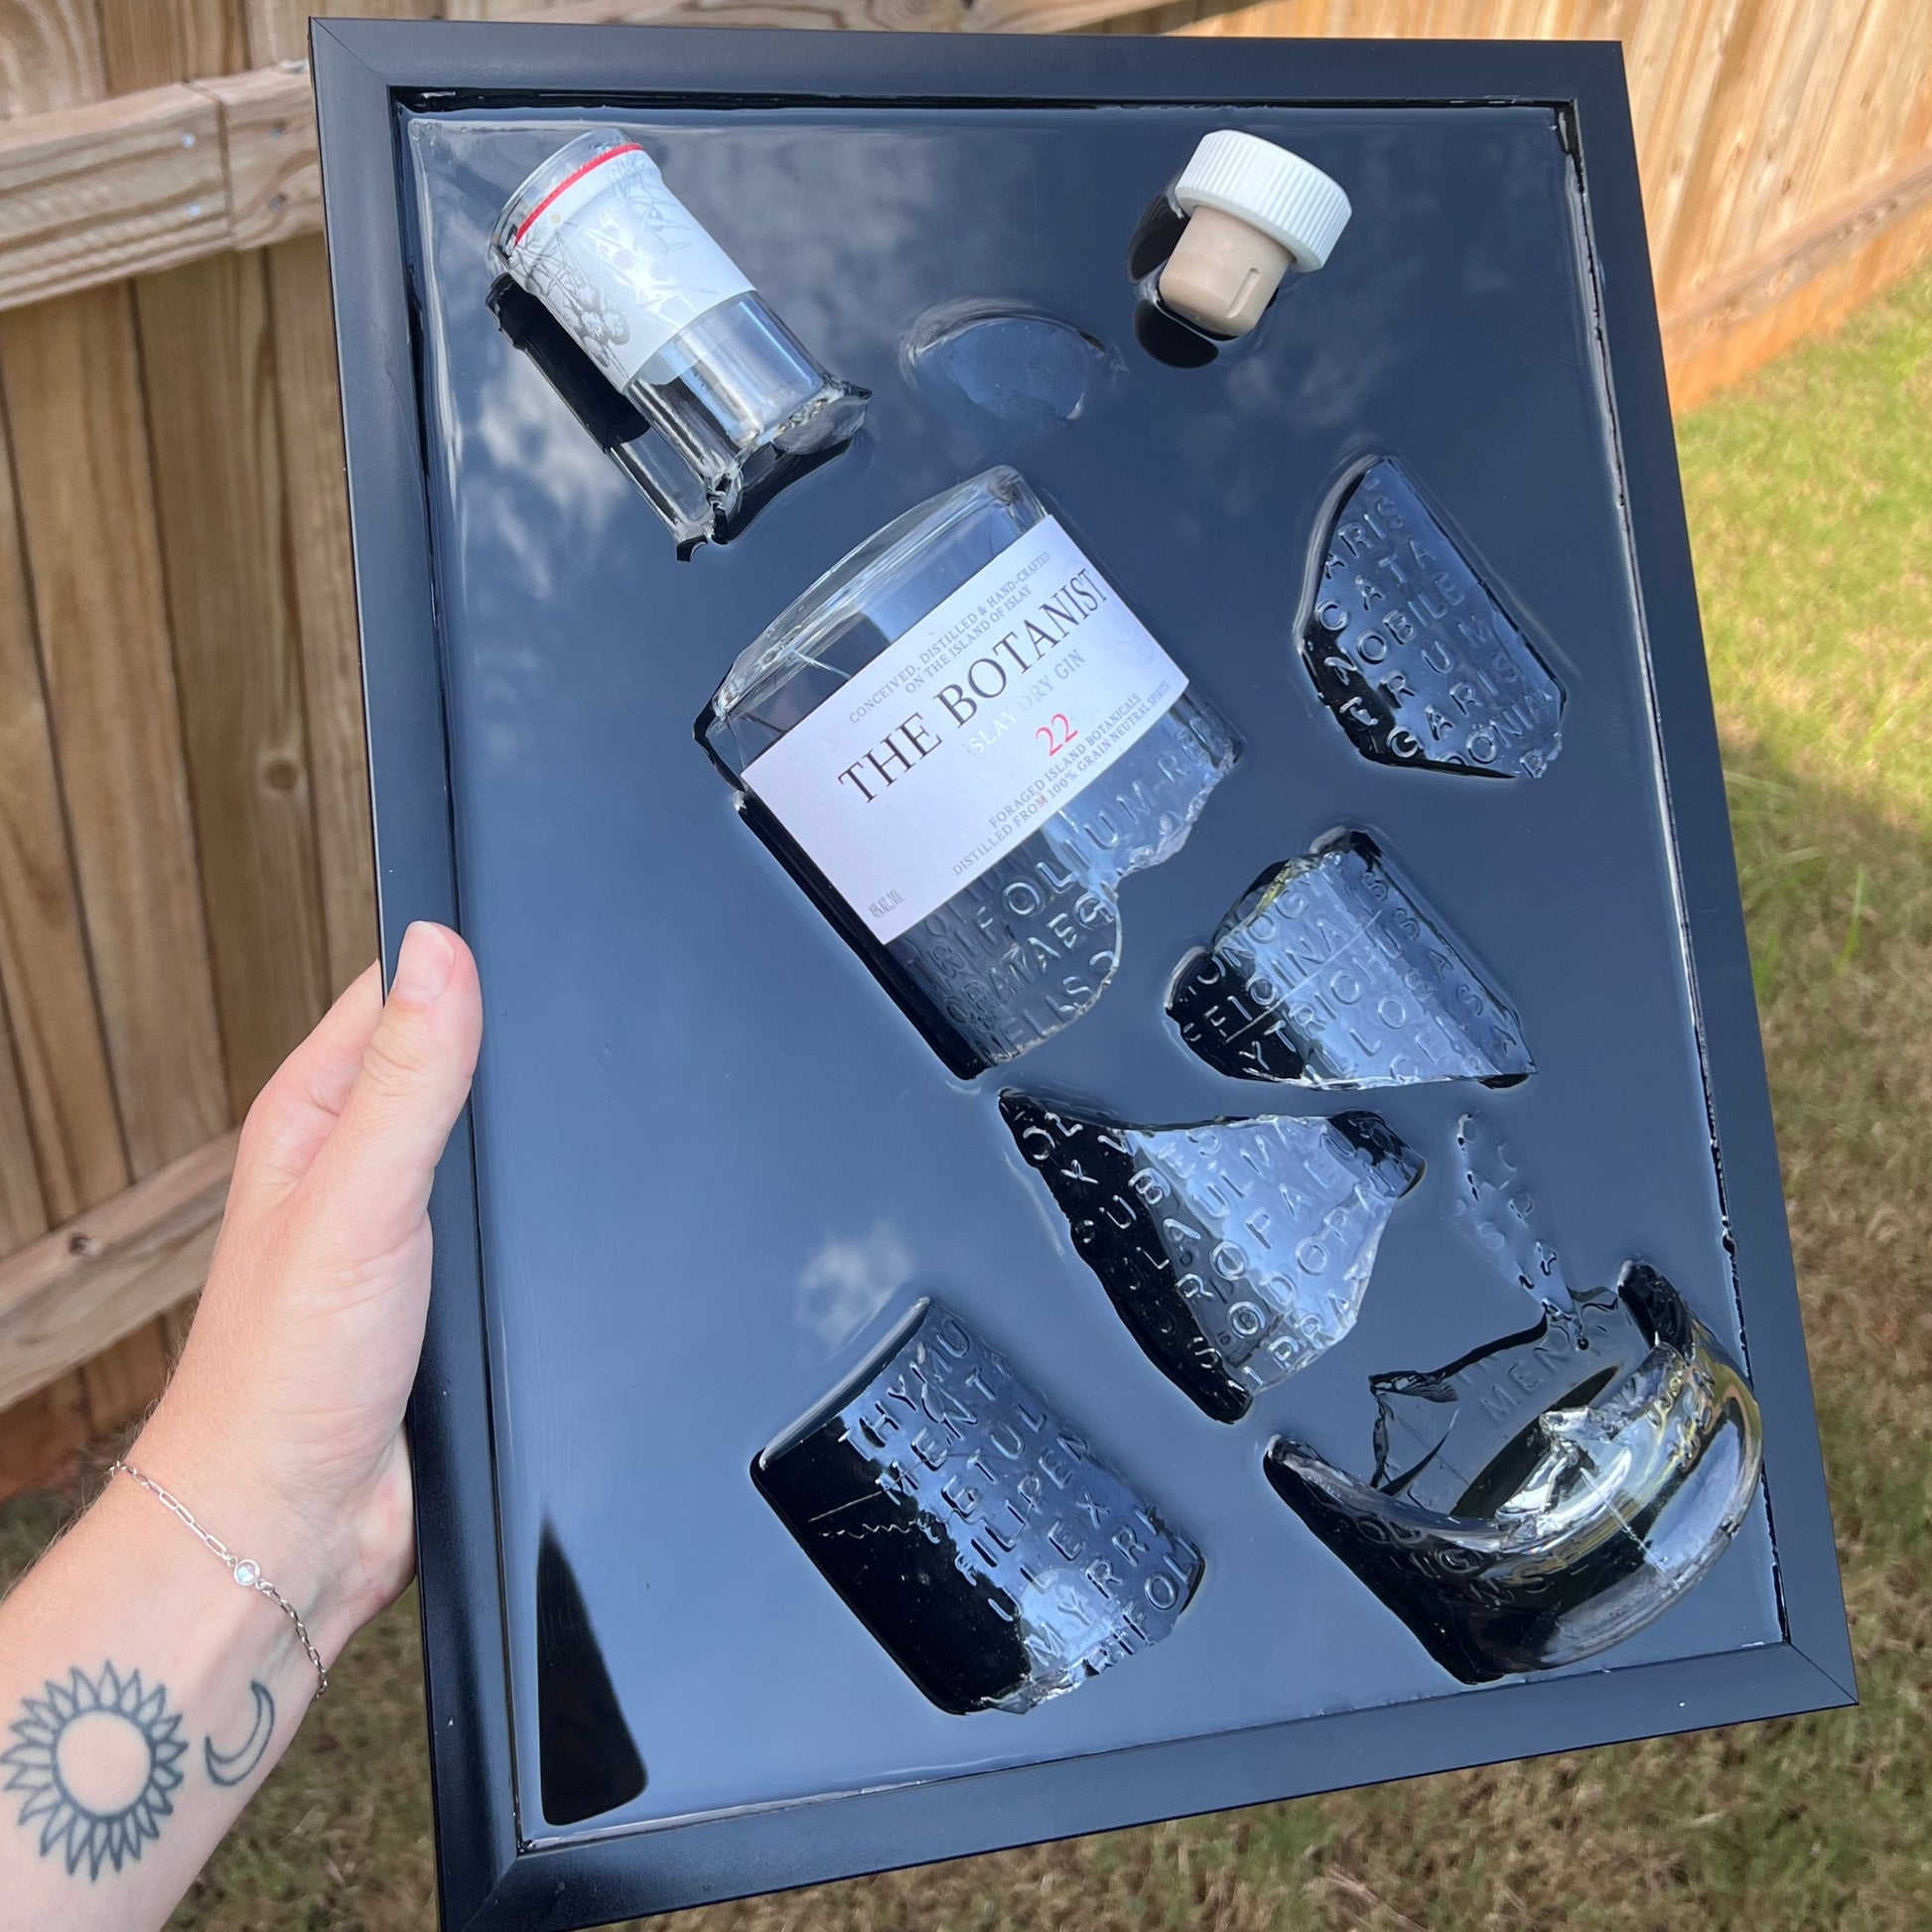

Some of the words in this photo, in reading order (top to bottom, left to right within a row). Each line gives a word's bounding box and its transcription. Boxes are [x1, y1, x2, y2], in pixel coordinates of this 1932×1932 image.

[904, 673, 927, 694] ON
[923, 653, 951, 678] THE
[948, 619, 992, 658] ISLAND
[988, 605, 1006, 622] OF
[1003, 584, 1033, 610] ISLAY
[918, 611, 978, 664] DISTILLED
[977, 604, 989, 616] &
[985, 550, 1052, 607] HAND-CRAFTED
[837, 711, 943, 802] THE
[932, 568, 1107, 728] BOTANIST
[1017, 674, 1055, 711] DRY
[1051, 648, 1086, 681] GIN
[1033, 710, 1079, 757] 22
[951, 822, 1014, 876] DISTILLED
[1012, 793, 1048, 827] FROM
[1046, 767, 1078, 798] 100%
[1075, 737, 1112, 771] GRAIN
[1108, 700, 1152, 743] NEUTRAL
[1146, 679, 1171, 707] SPIRITS
[988, 777, 1045, 828] FORAGED
[1043, 741, 1088, 781] ISLAND
[1084, 692, 1142, 747] BOTANICALS
[987, 1491, 1114, 1623] ULEX
